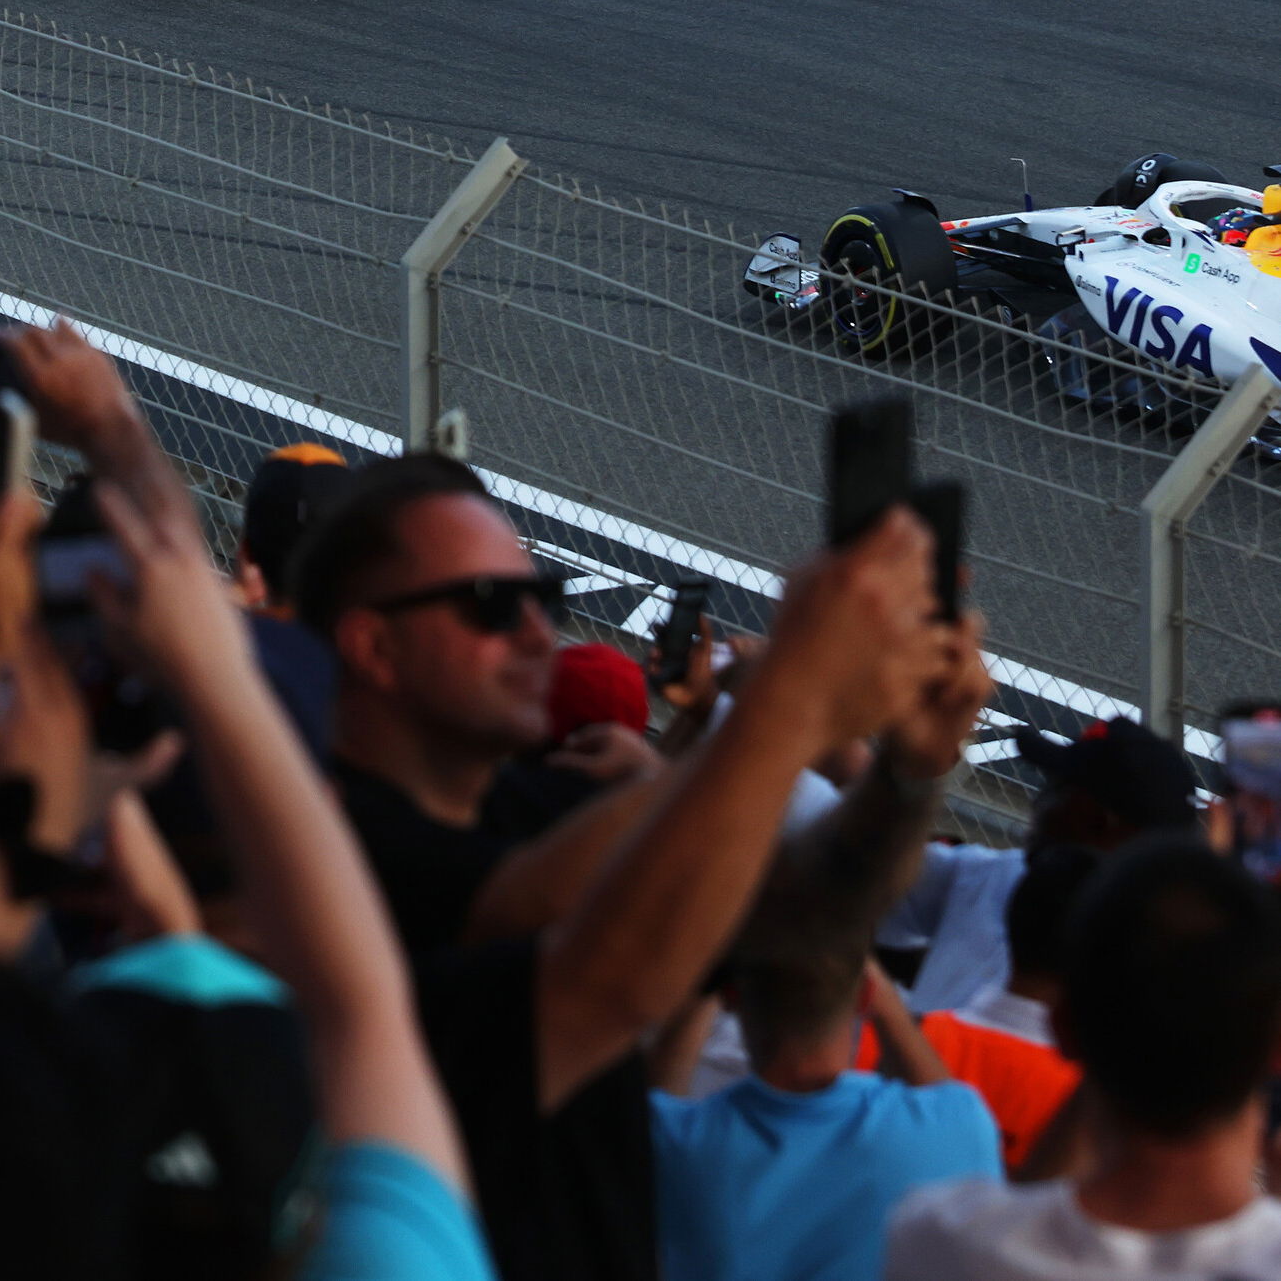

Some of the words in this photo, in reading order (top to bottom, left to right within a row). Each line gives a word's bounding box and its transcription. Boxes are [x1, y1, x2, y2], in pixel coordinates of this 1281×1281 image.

[1201, 262, 1222, 278] Cash
[1222, 268, 1241, 285] App
[1104, 275, 1215, 379] VISA
